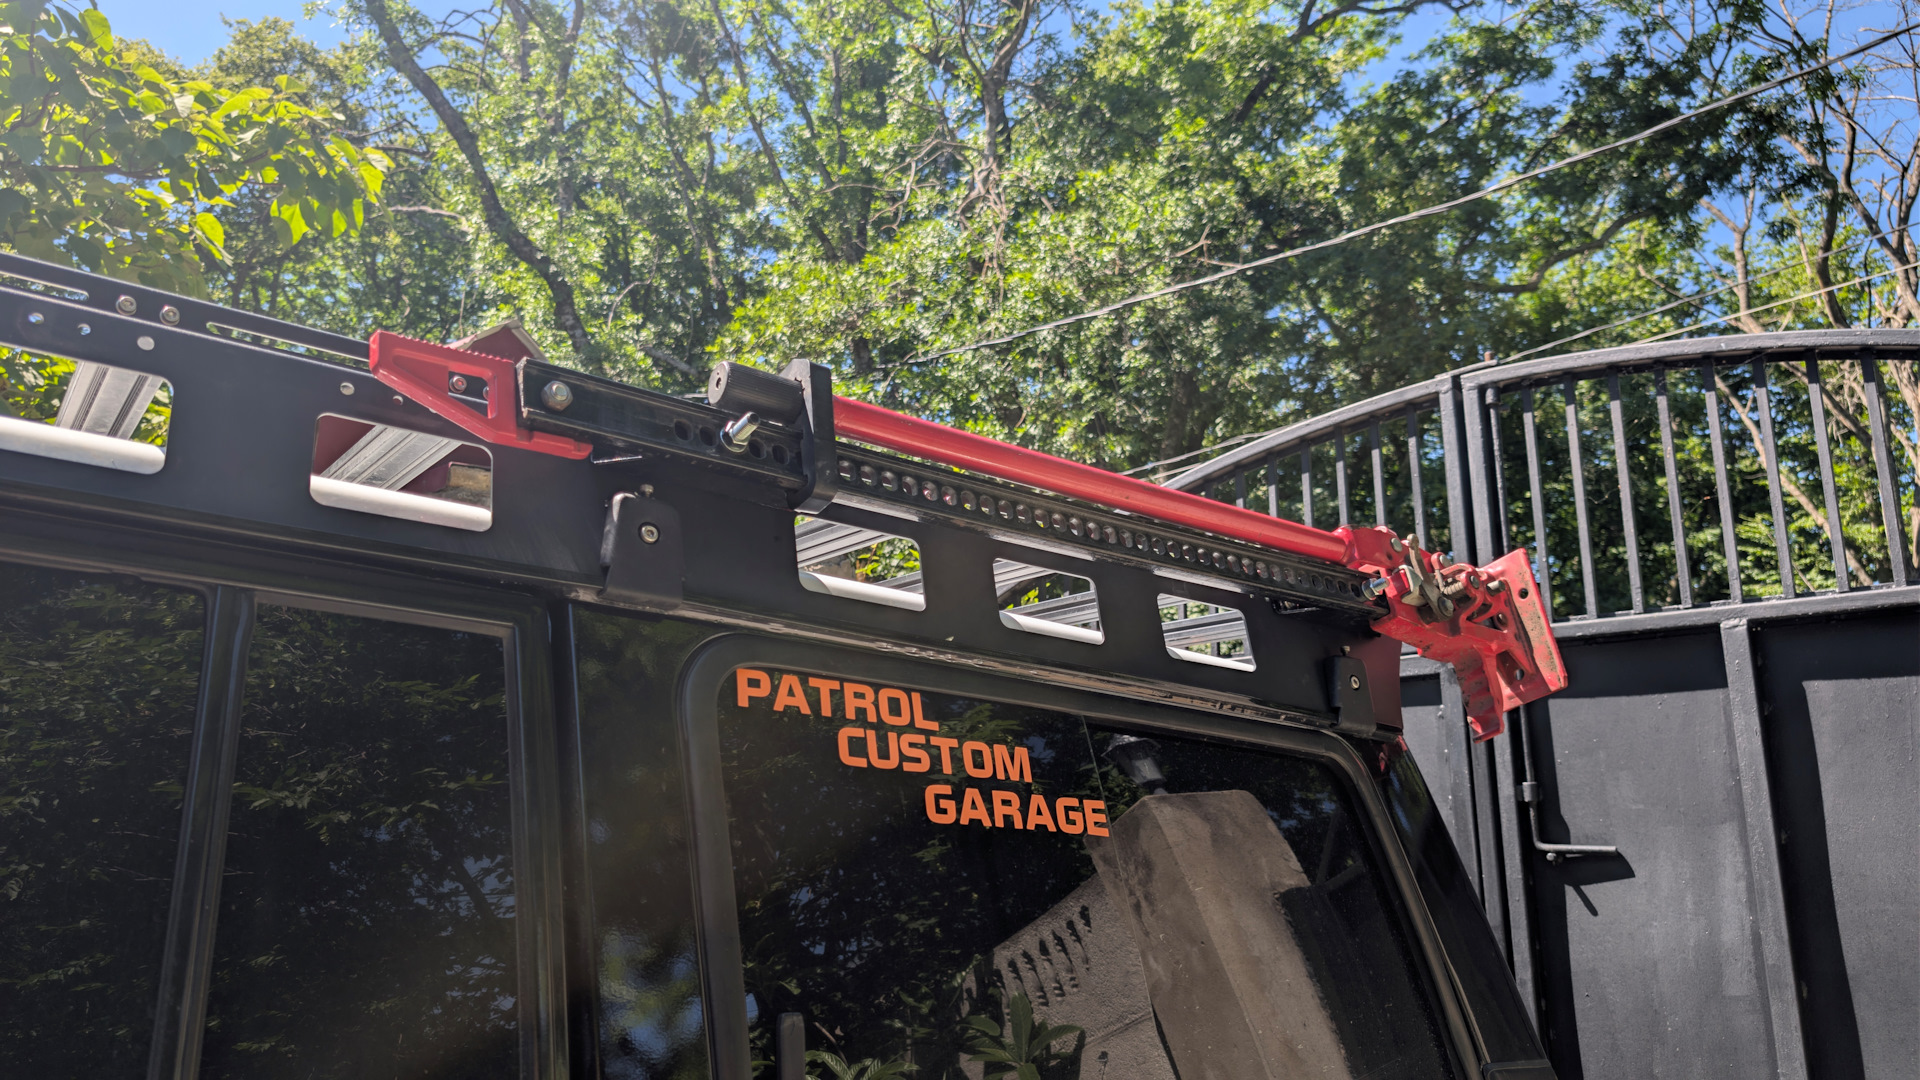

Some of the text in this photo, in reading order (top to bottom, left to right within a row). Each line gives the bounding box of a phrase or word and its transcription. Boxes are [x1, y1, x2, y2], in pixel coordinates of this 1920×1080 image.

[736, 668, 940, 732] PATROL
[837, 726, 1033, 783] CUSTOM
[924, 784, 1110, 838] GARAGE
